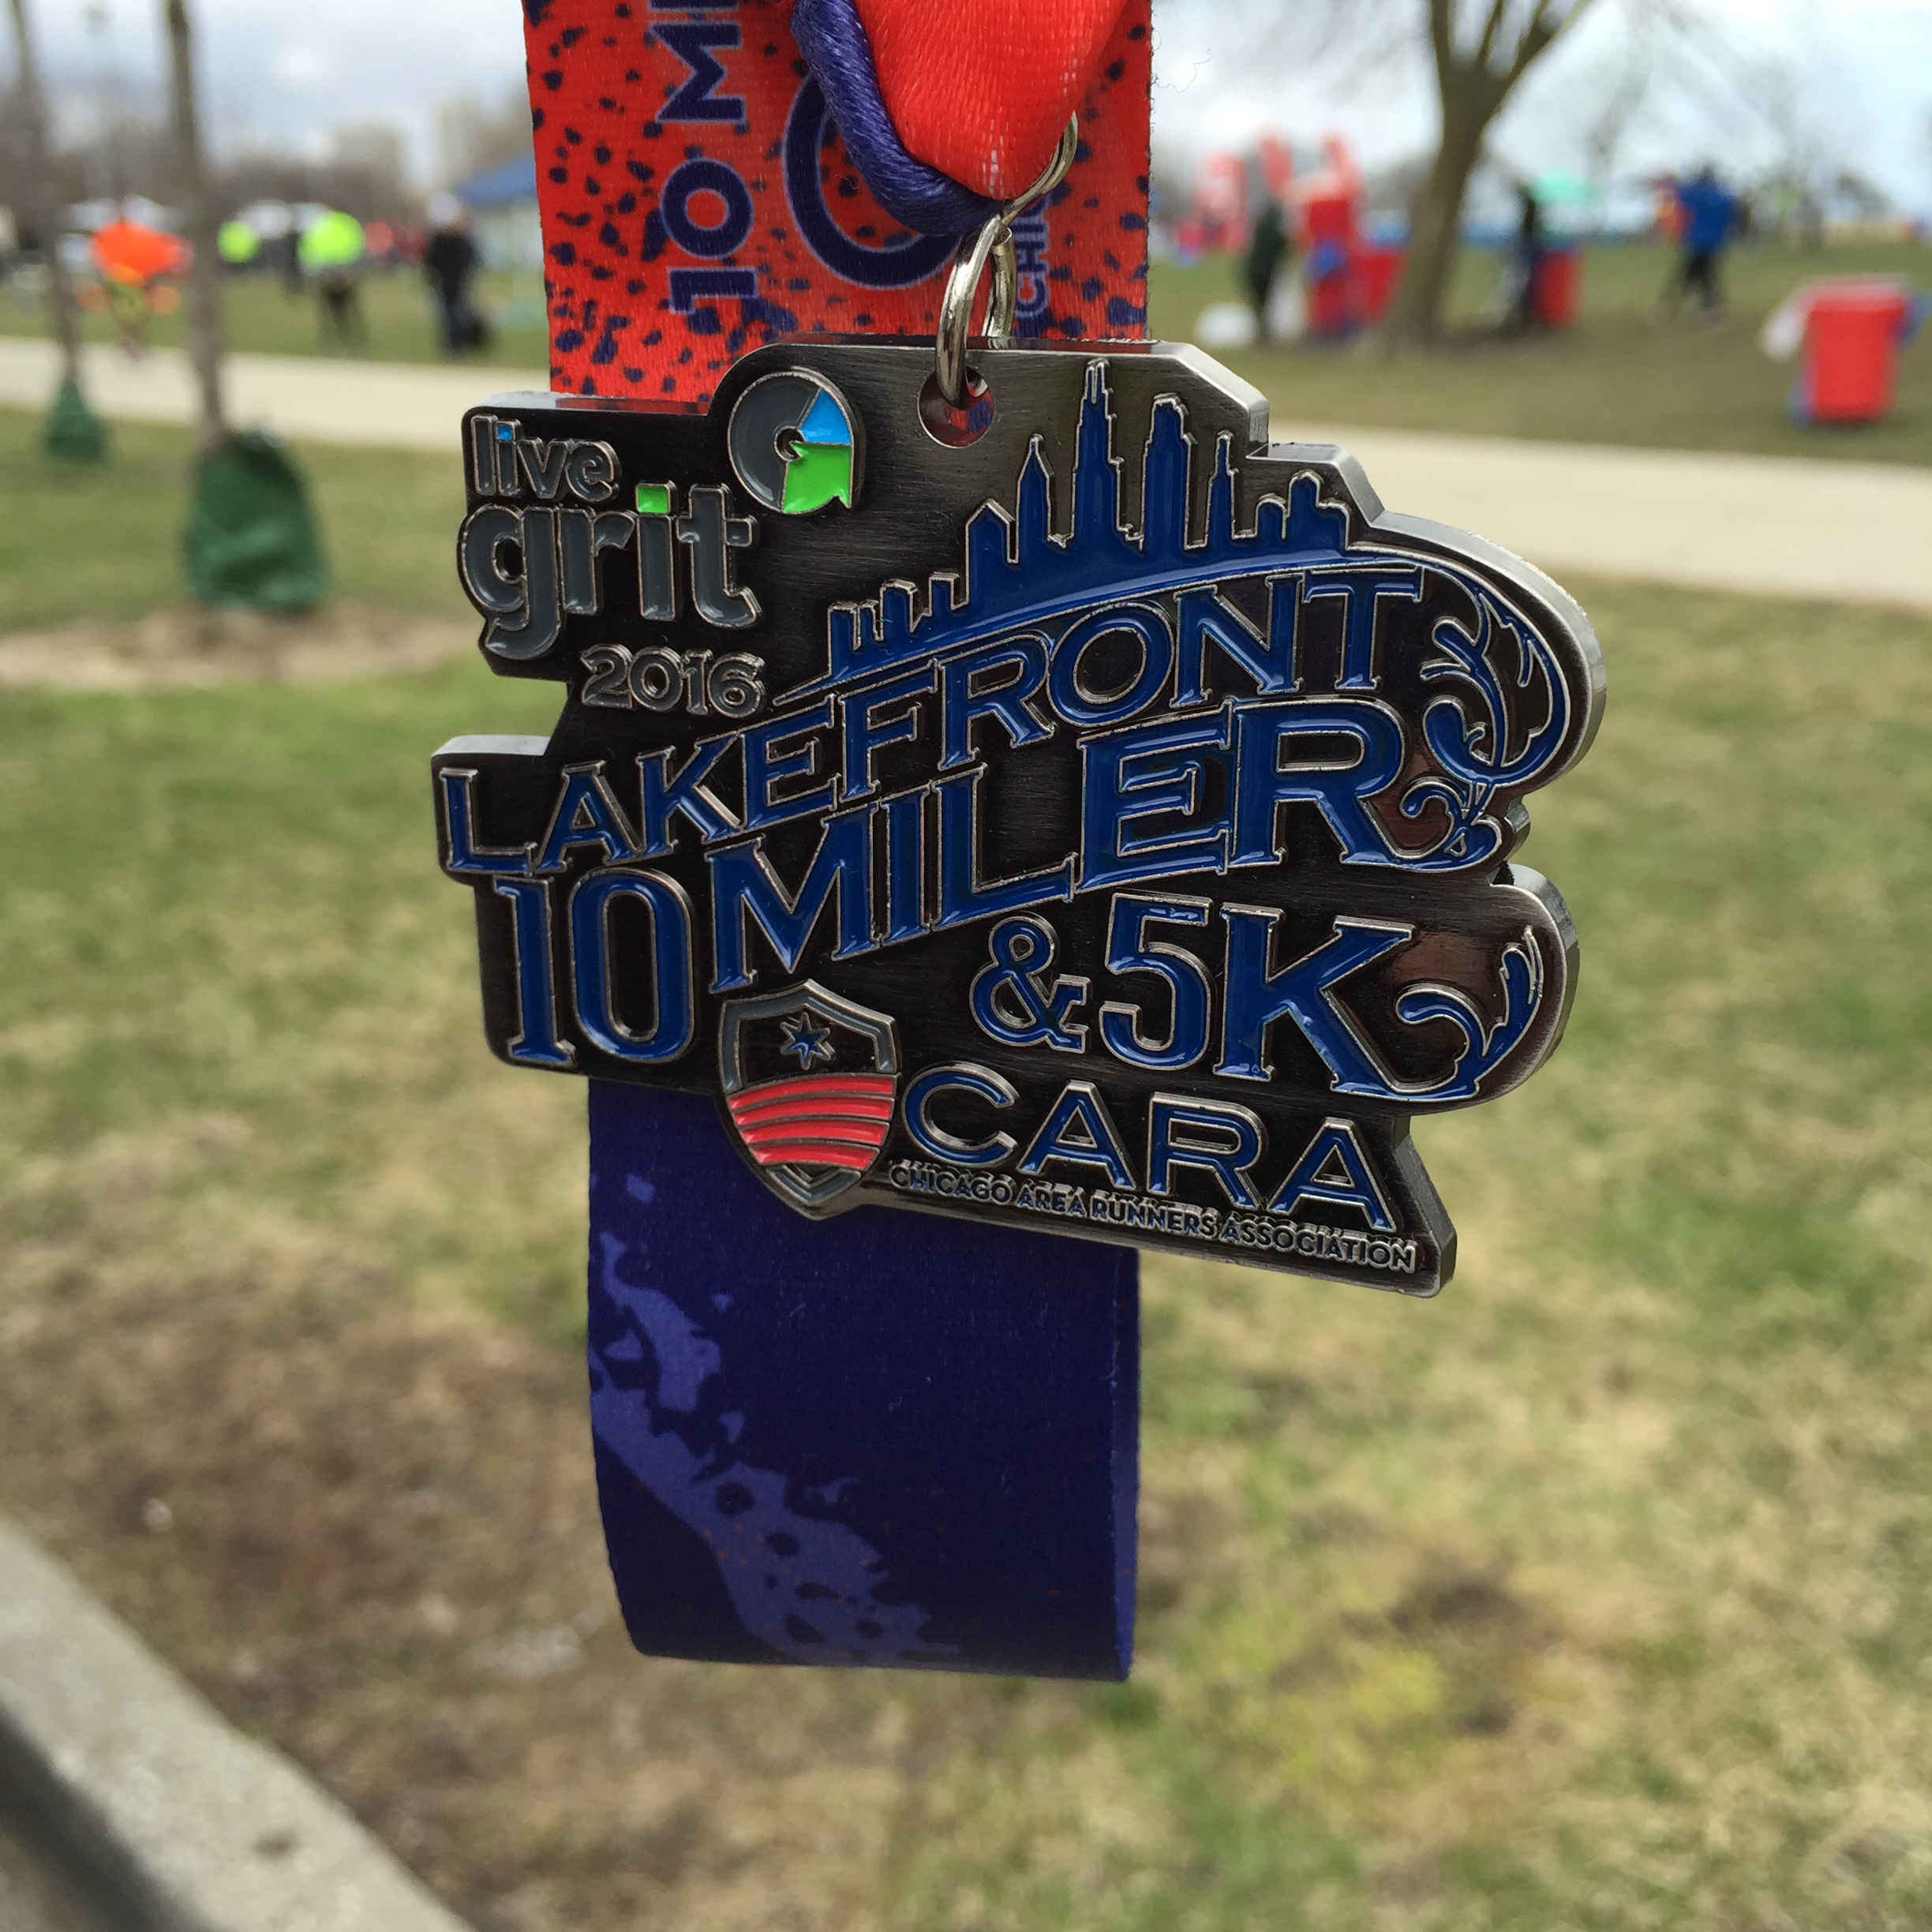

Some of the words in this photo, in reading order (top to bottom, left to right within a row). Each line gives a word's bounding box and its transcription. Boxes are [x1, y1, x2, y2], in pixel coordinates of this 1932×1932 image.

[659, 158, 758, 315] 10
[471, 413, 621, 503] live
[461, 480, 762, 661] grit
[440, 563, 1422, 877] LAKEFRONT
[579, 642, 769, 719] 2016
[492, 867, 698, 1069] 10
[704, 695, 1421, 994] MILER
[968, 910, 1092, 1054] &
[1099, 890, 1428, 1102] 5K
[889, 1159, 1017, 1206] CHICAGO
[1014, 1178, 1087, 1219] AREA
[1089, 1189, 1222, 1239] RUNNERS
[1218, 1211, 1420, 1274] ASSOCIATION
[900, 1061, 1405, 1233] CARA
